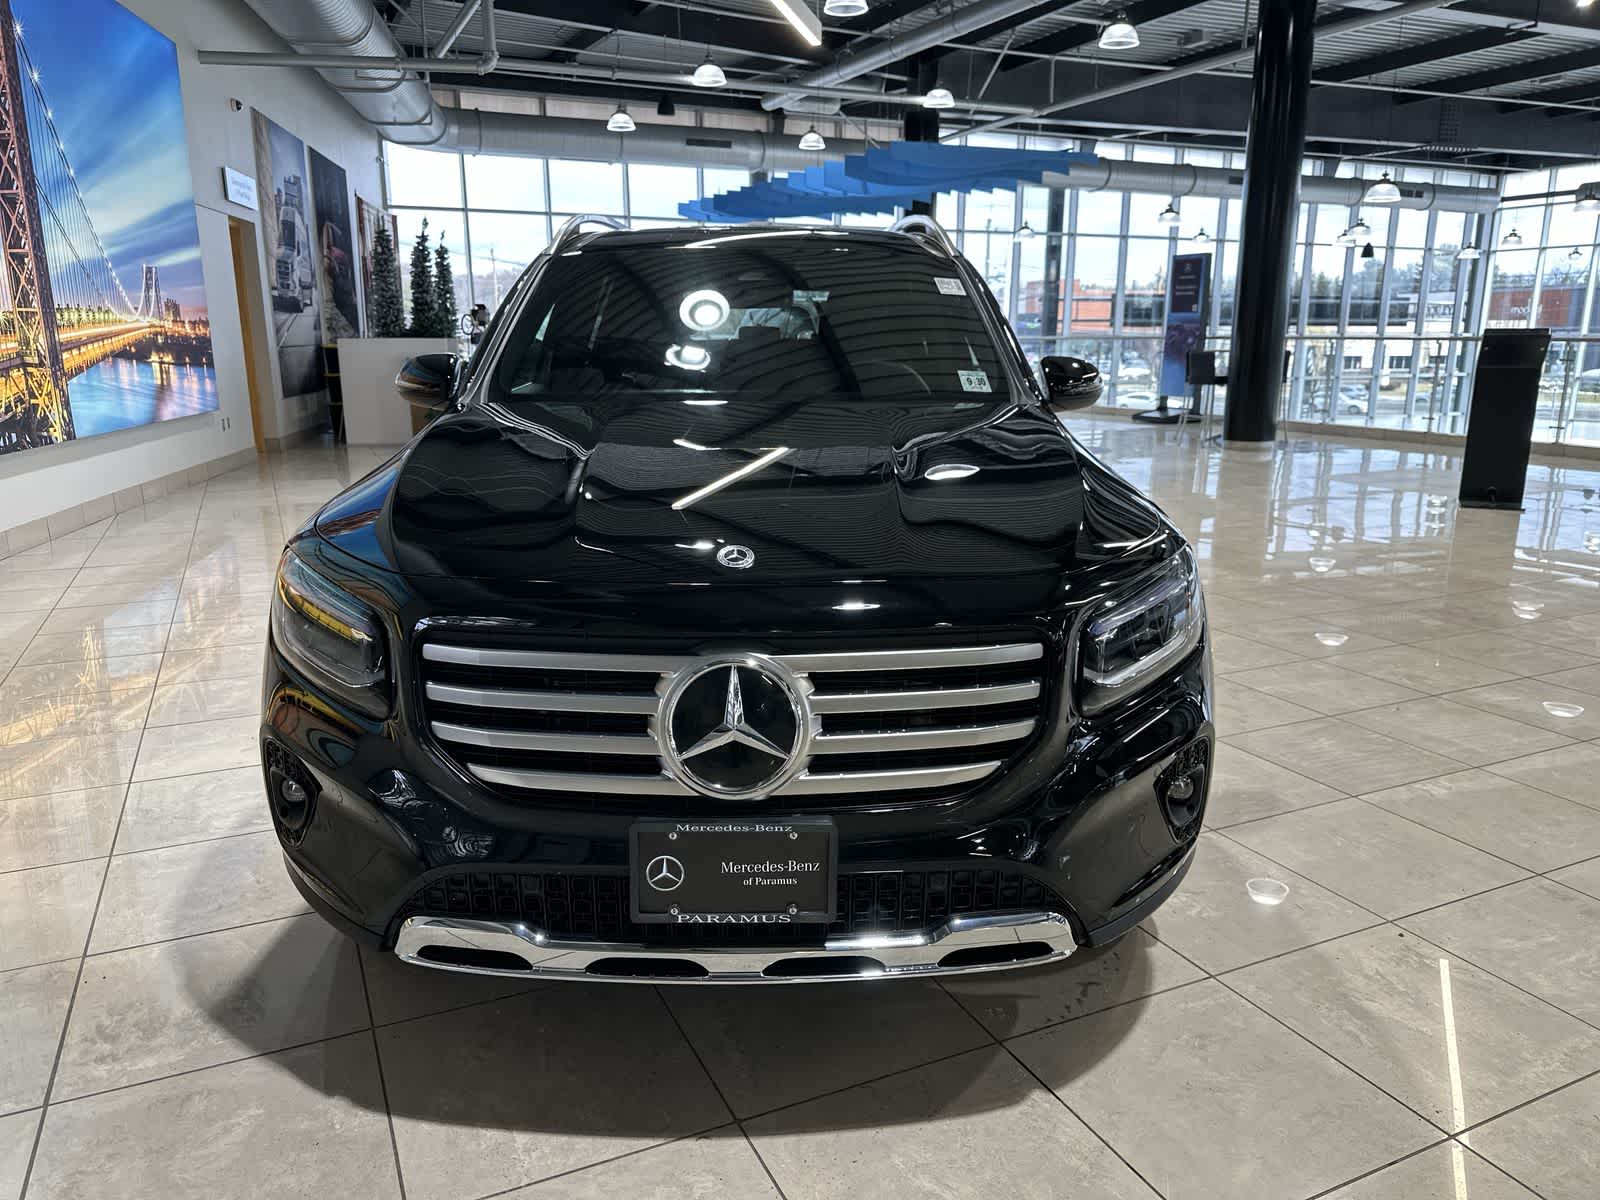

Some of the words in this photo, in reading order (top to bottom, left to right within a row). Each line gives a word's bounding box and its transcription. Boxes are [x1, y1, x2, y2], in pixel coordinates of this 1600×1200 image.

[676, 824, 793, 832] Mercedes-Benz
[721, 860, 820, 874] Mercedes-Benz
[743, 877, 753, 886] of
[755, 876, 798, 886] Paramus
[676, 914, 791, 923] PARAMUS
